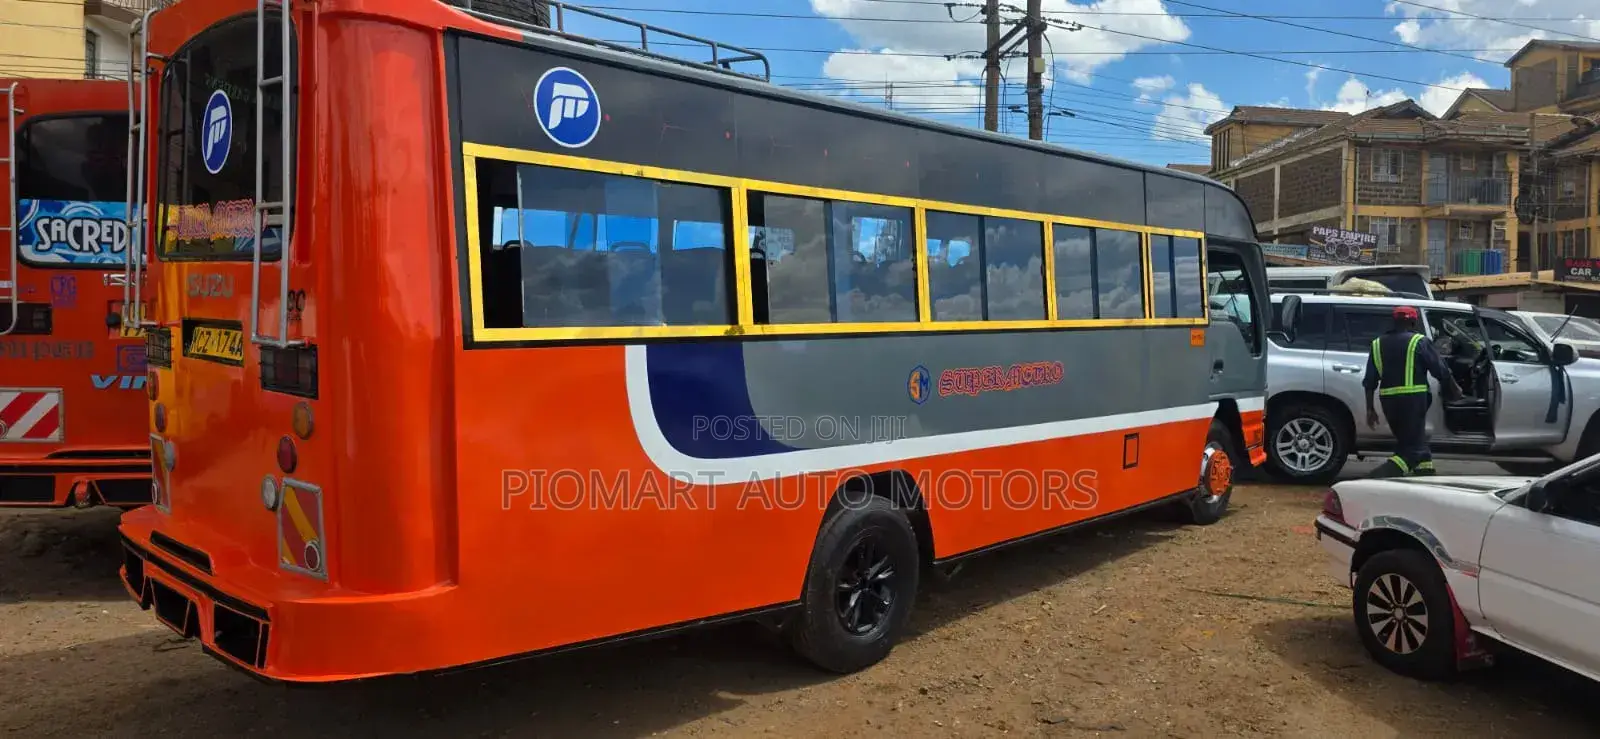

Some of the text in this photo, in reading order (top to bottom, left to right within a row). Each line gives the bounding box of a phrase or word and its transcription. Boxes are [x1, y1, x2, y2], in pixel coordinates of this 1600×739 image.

[36, 217, 128, 254] SACRED
[1313, 226, 1338, 238] PAPS
[1340, 230, 1377, 243] EMPIRE
[1570, 267, 1592, 276] CAR
